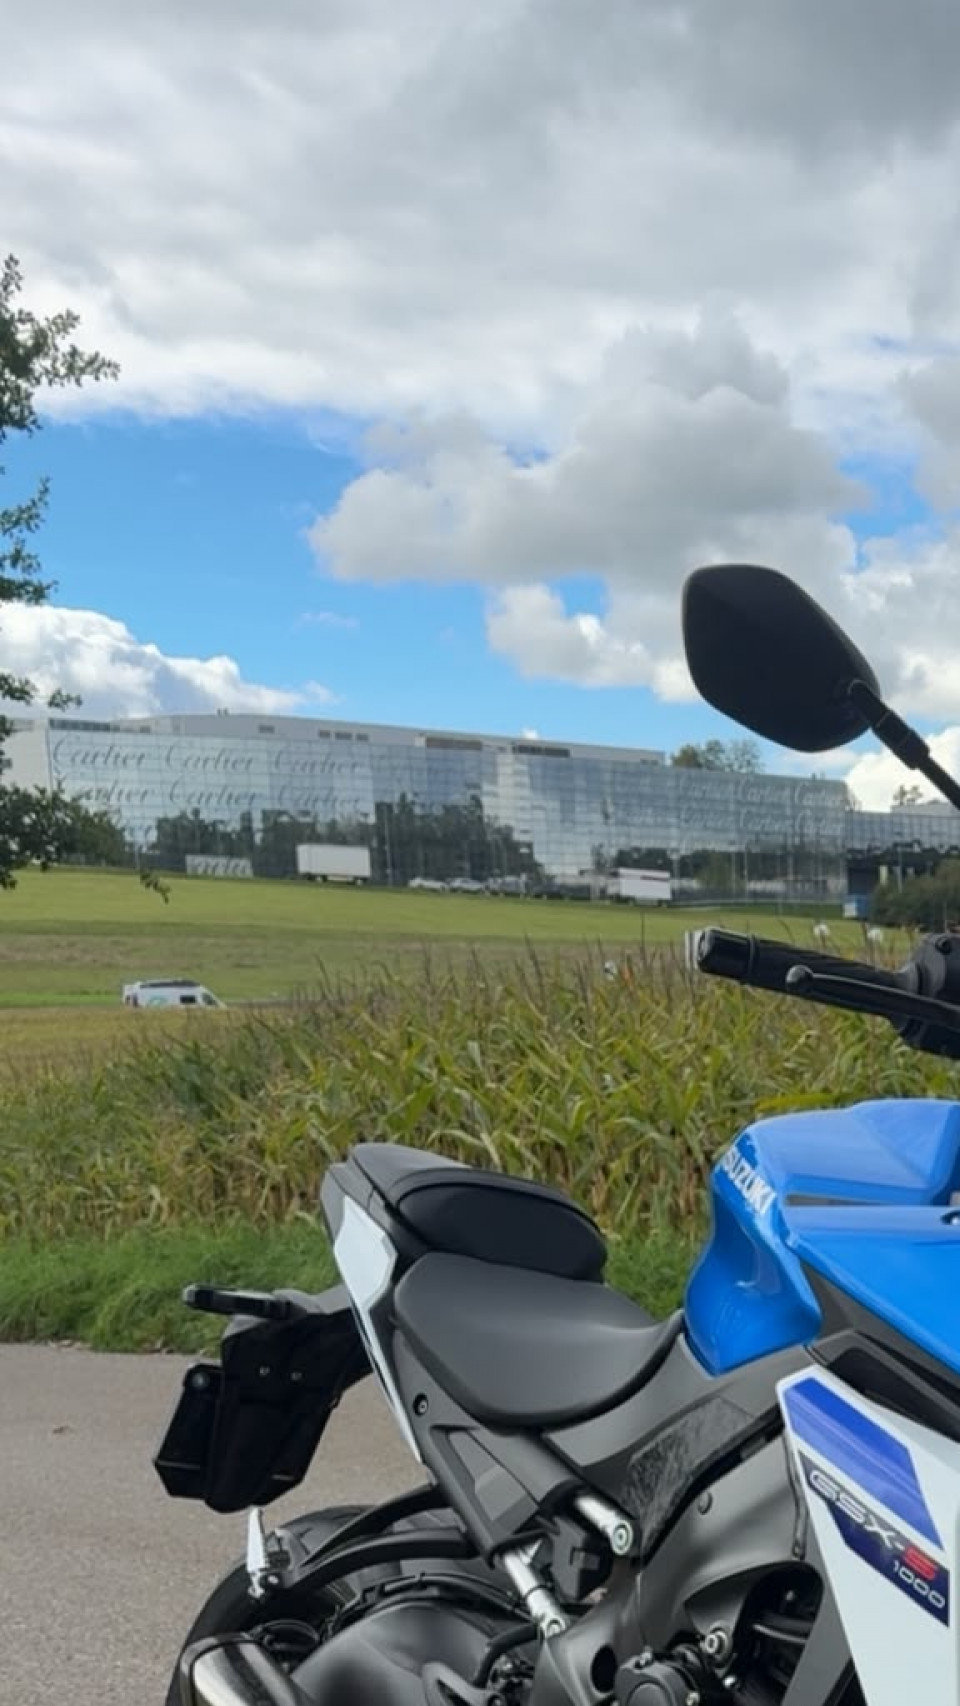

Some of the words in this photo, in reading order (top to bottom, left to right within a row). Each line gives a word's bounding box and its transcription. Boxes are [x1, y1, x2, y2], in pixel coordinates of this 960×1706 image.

[53, 733, 146, 768] Cartier
[165, 741, 253, 770] Cartier
[273, 749, 361, 774] Cartier
[169, 775, 257, 806] Cartier
[722, 1146, 777, 1216] SUZUKI
[809, 1470, 939, 1581] GSX-S
[893, 1560, 945, 1609] 1000
